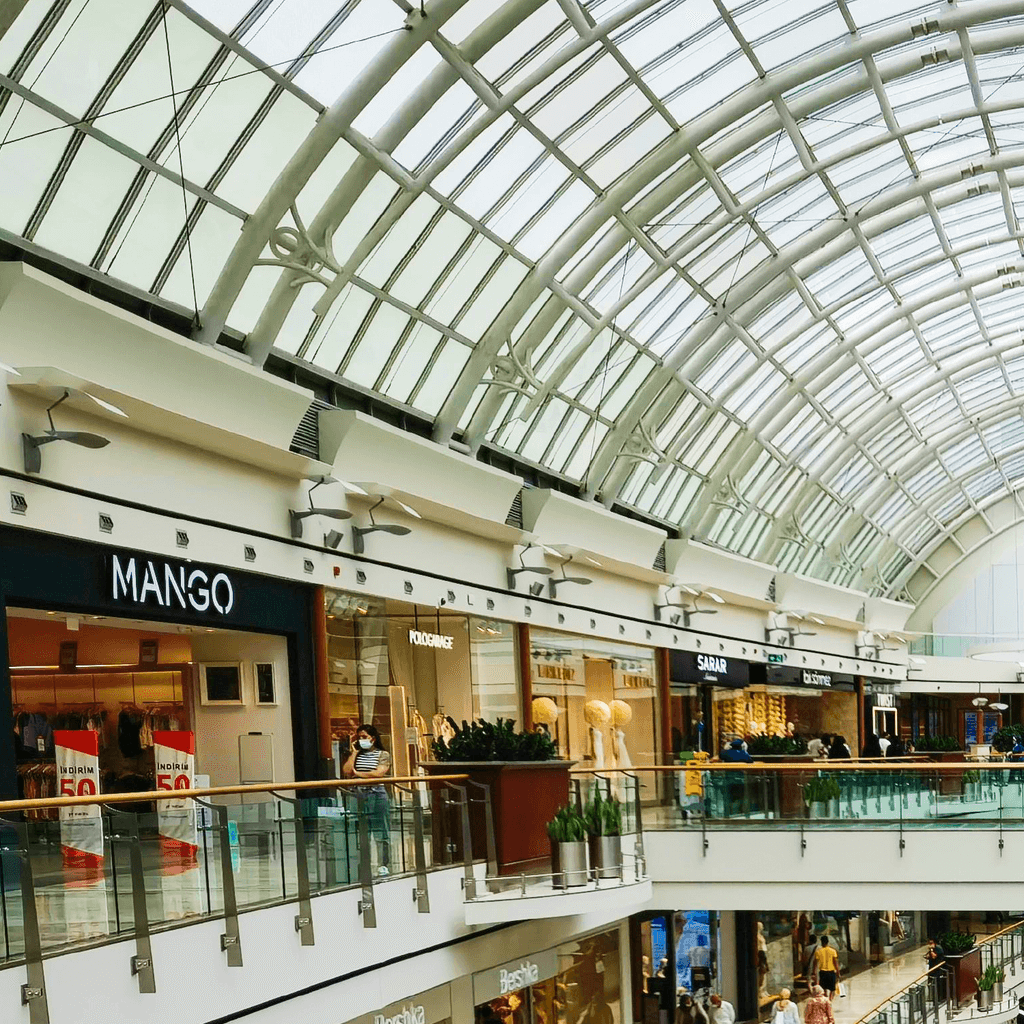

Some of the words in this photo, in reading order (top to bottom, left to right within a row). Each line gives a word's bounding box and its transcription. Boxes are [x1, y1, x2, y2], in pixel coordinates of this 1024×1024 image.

[112, 554, 234, 615] MANGO
[697, 654, 728, 674] SARAR
[59, 765, 95, 774] İNDİRİM
[60, 778, 96, 798] 50
[157, 774, 190, 792] 50
[500, 960, 539, 994] Bershka
